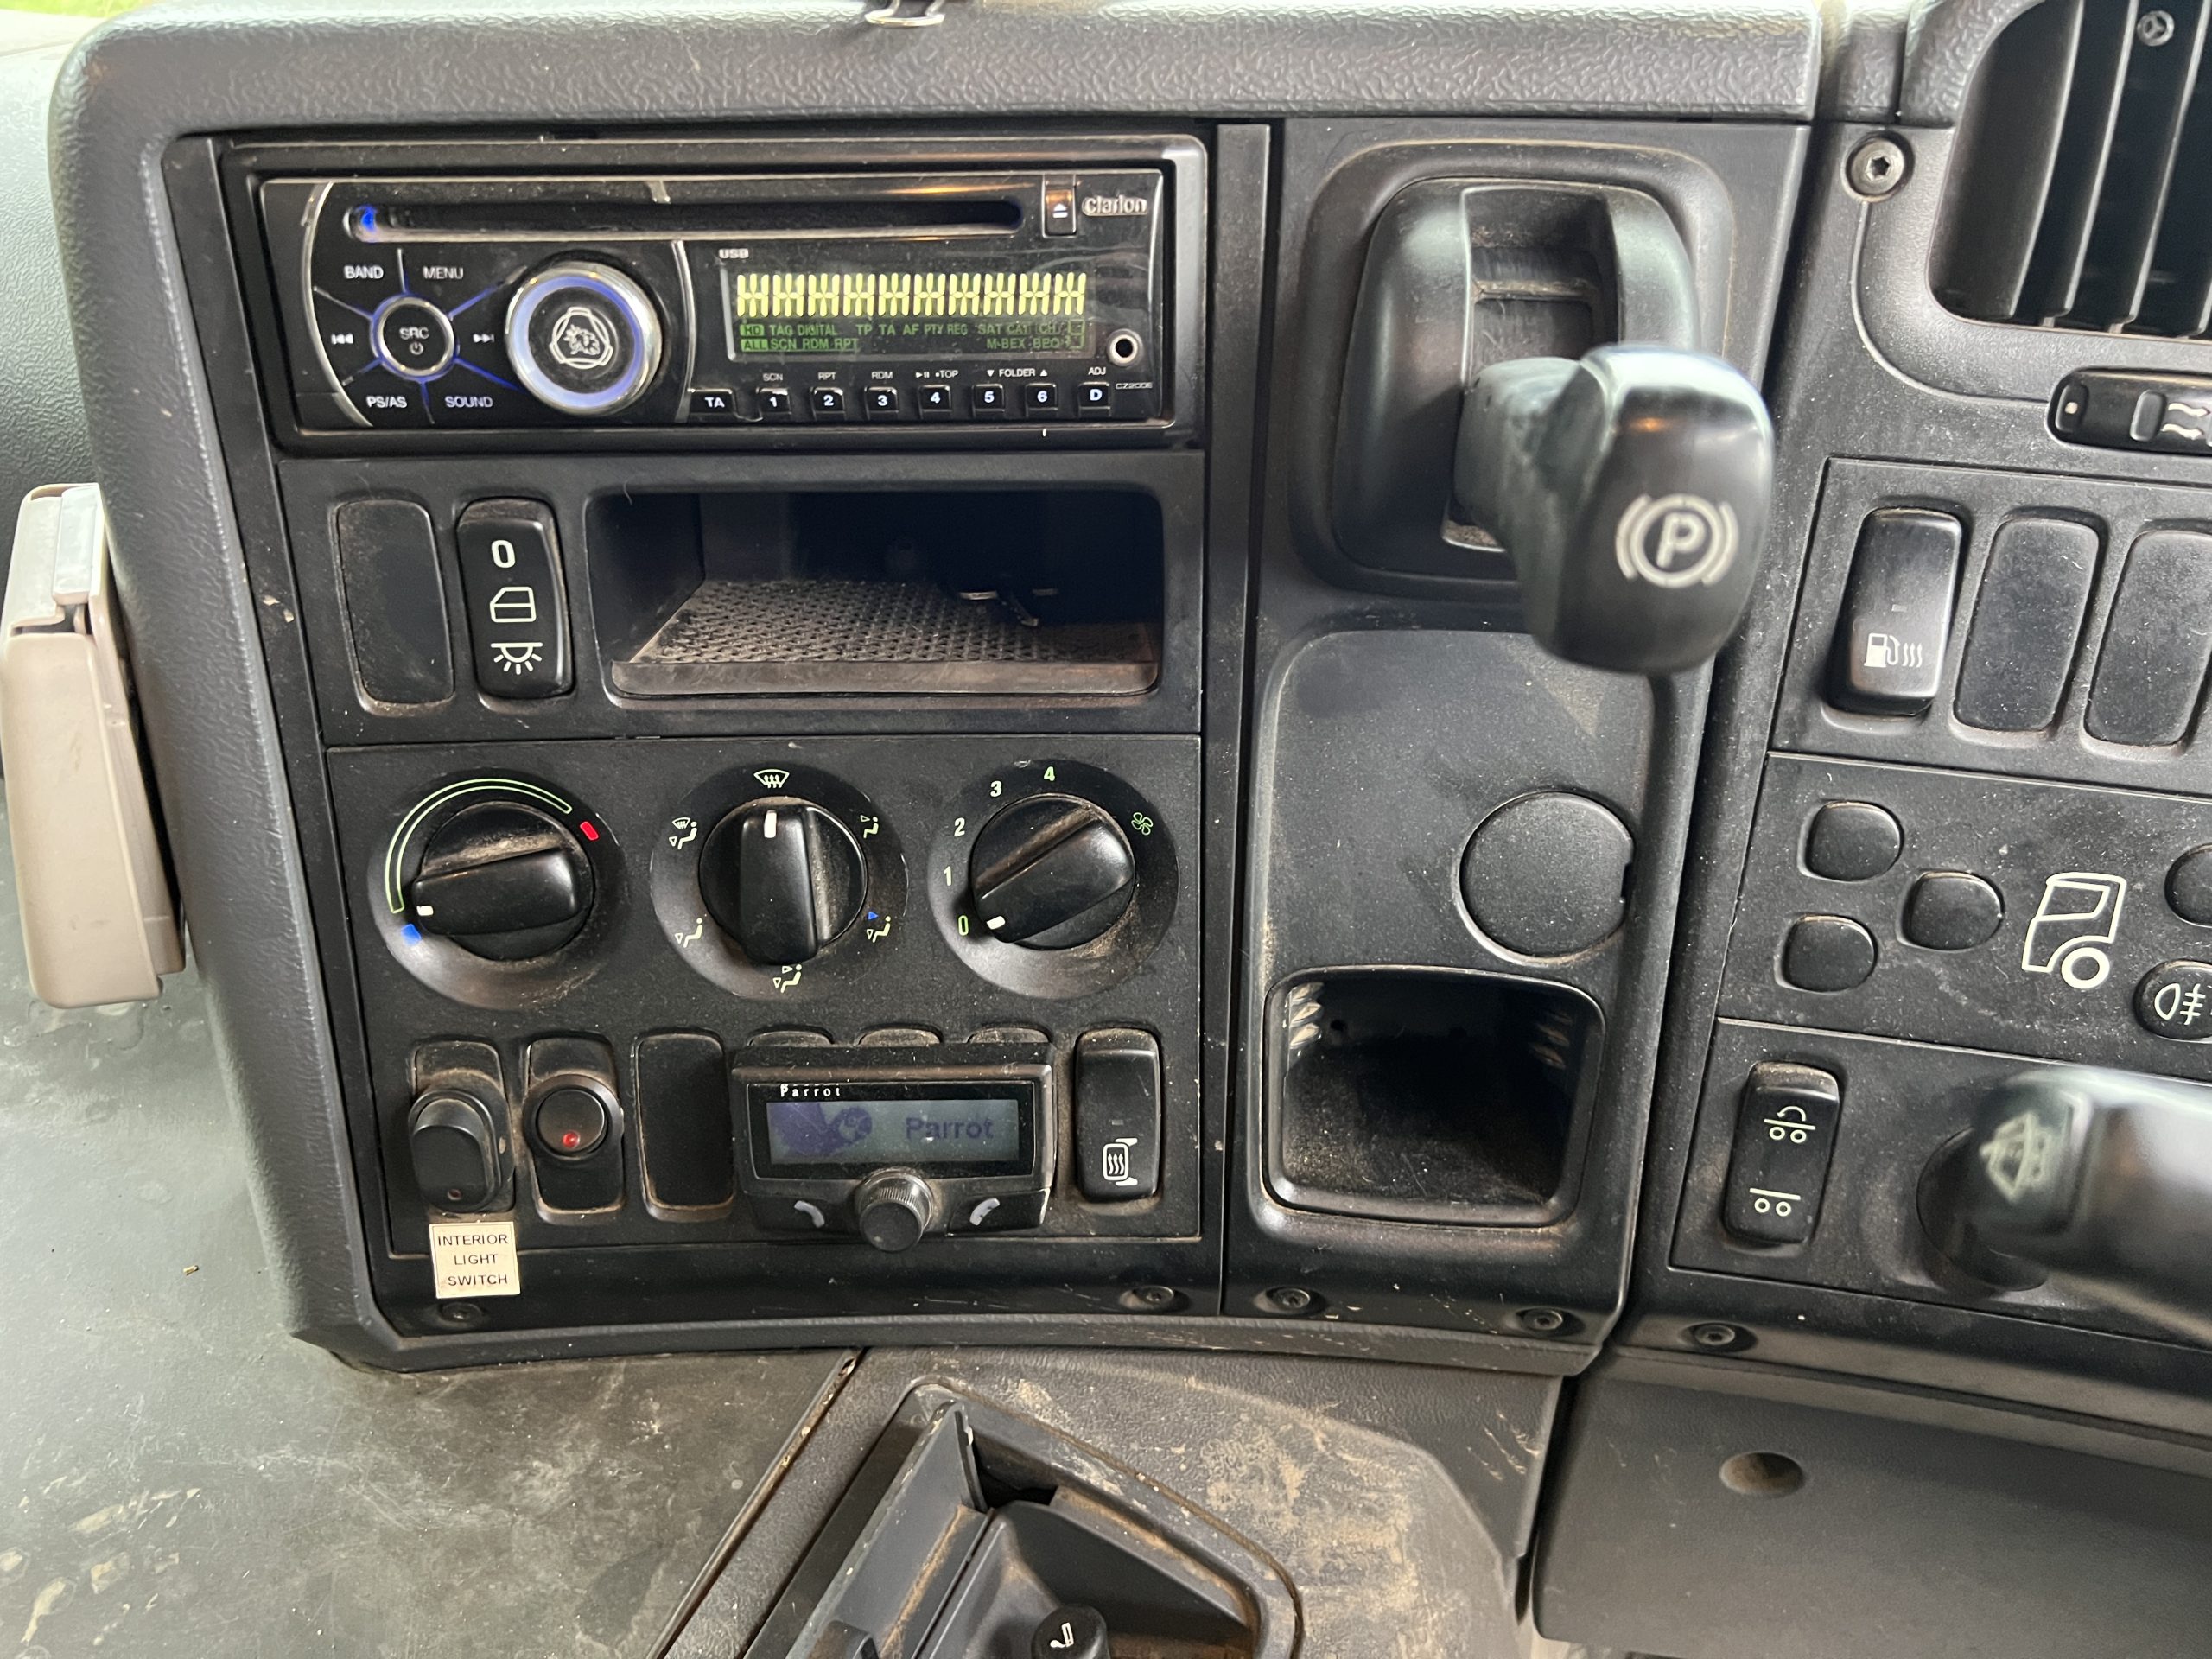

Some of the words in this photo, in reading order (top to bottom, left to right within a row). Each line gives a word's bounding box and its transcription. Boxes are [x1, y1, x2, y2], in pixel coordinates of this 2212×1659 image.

[719, 248, 749, 259] USB
[344, 265, 384, 279] BAND
[423, 266, 464, 279] MENU
[398, 327, 429, 340] SRC
[769, 324, 793, 336] TAG
[798, 324, 838, 336] DIGITAL
[855, 324, 873, 335] TP
[879, 324, 896, 335] TA
[902, 323, 919, 335] AF
[924, 323, 944, 335] PTY
[947, 323, 969, 335] REG
[977, 323, 1002, 335] SAT
[742, 338, 768, 351] ALL
[770, 338, 797, 350] SCN
[802, 338, 829, 350] RDM
[835, 338, 859, 350] RPT
[762, 372, 784, 381] SCN
[817, 372, 836, 380] RPT
[871, 371, 893, 379] RDM
[999, 369, 1036, 378] FOLDER
[1087, 366, 1107, 376] ADJ
[769, 396, 778, 407] 1
[823, 395, 834, 406] 2
[877, 395, 888, 406] 3
[930, 391, 941, 404] 4
[984, 391, 995, 403] 5
[1037, 390, 1048, 403] 6
[1090, 389, 1103, 401] D
[366, 396, 407, 409] PS/AS
[445, 396, 493, 409] SOUND
[704, 396, 725, 408] TA
[1656, 512, 1706, 569] P
[1043, 766, 1056, 782] 4
[989, 780, 1002, 798] 3
[954, 817, 966, 837] 2
[944, 866, 952, 887] 1
[957, 914, 969, 936] 0
[780, 1083, 841, 1097] Parrot
[905, 1115, 995, 1141] Parrot
[438, 1234, 509, 1246] INTERIOR
[454, 1253, 499, 1266] LIGHT
[448, 1274, 508, 1287] SWITCH
